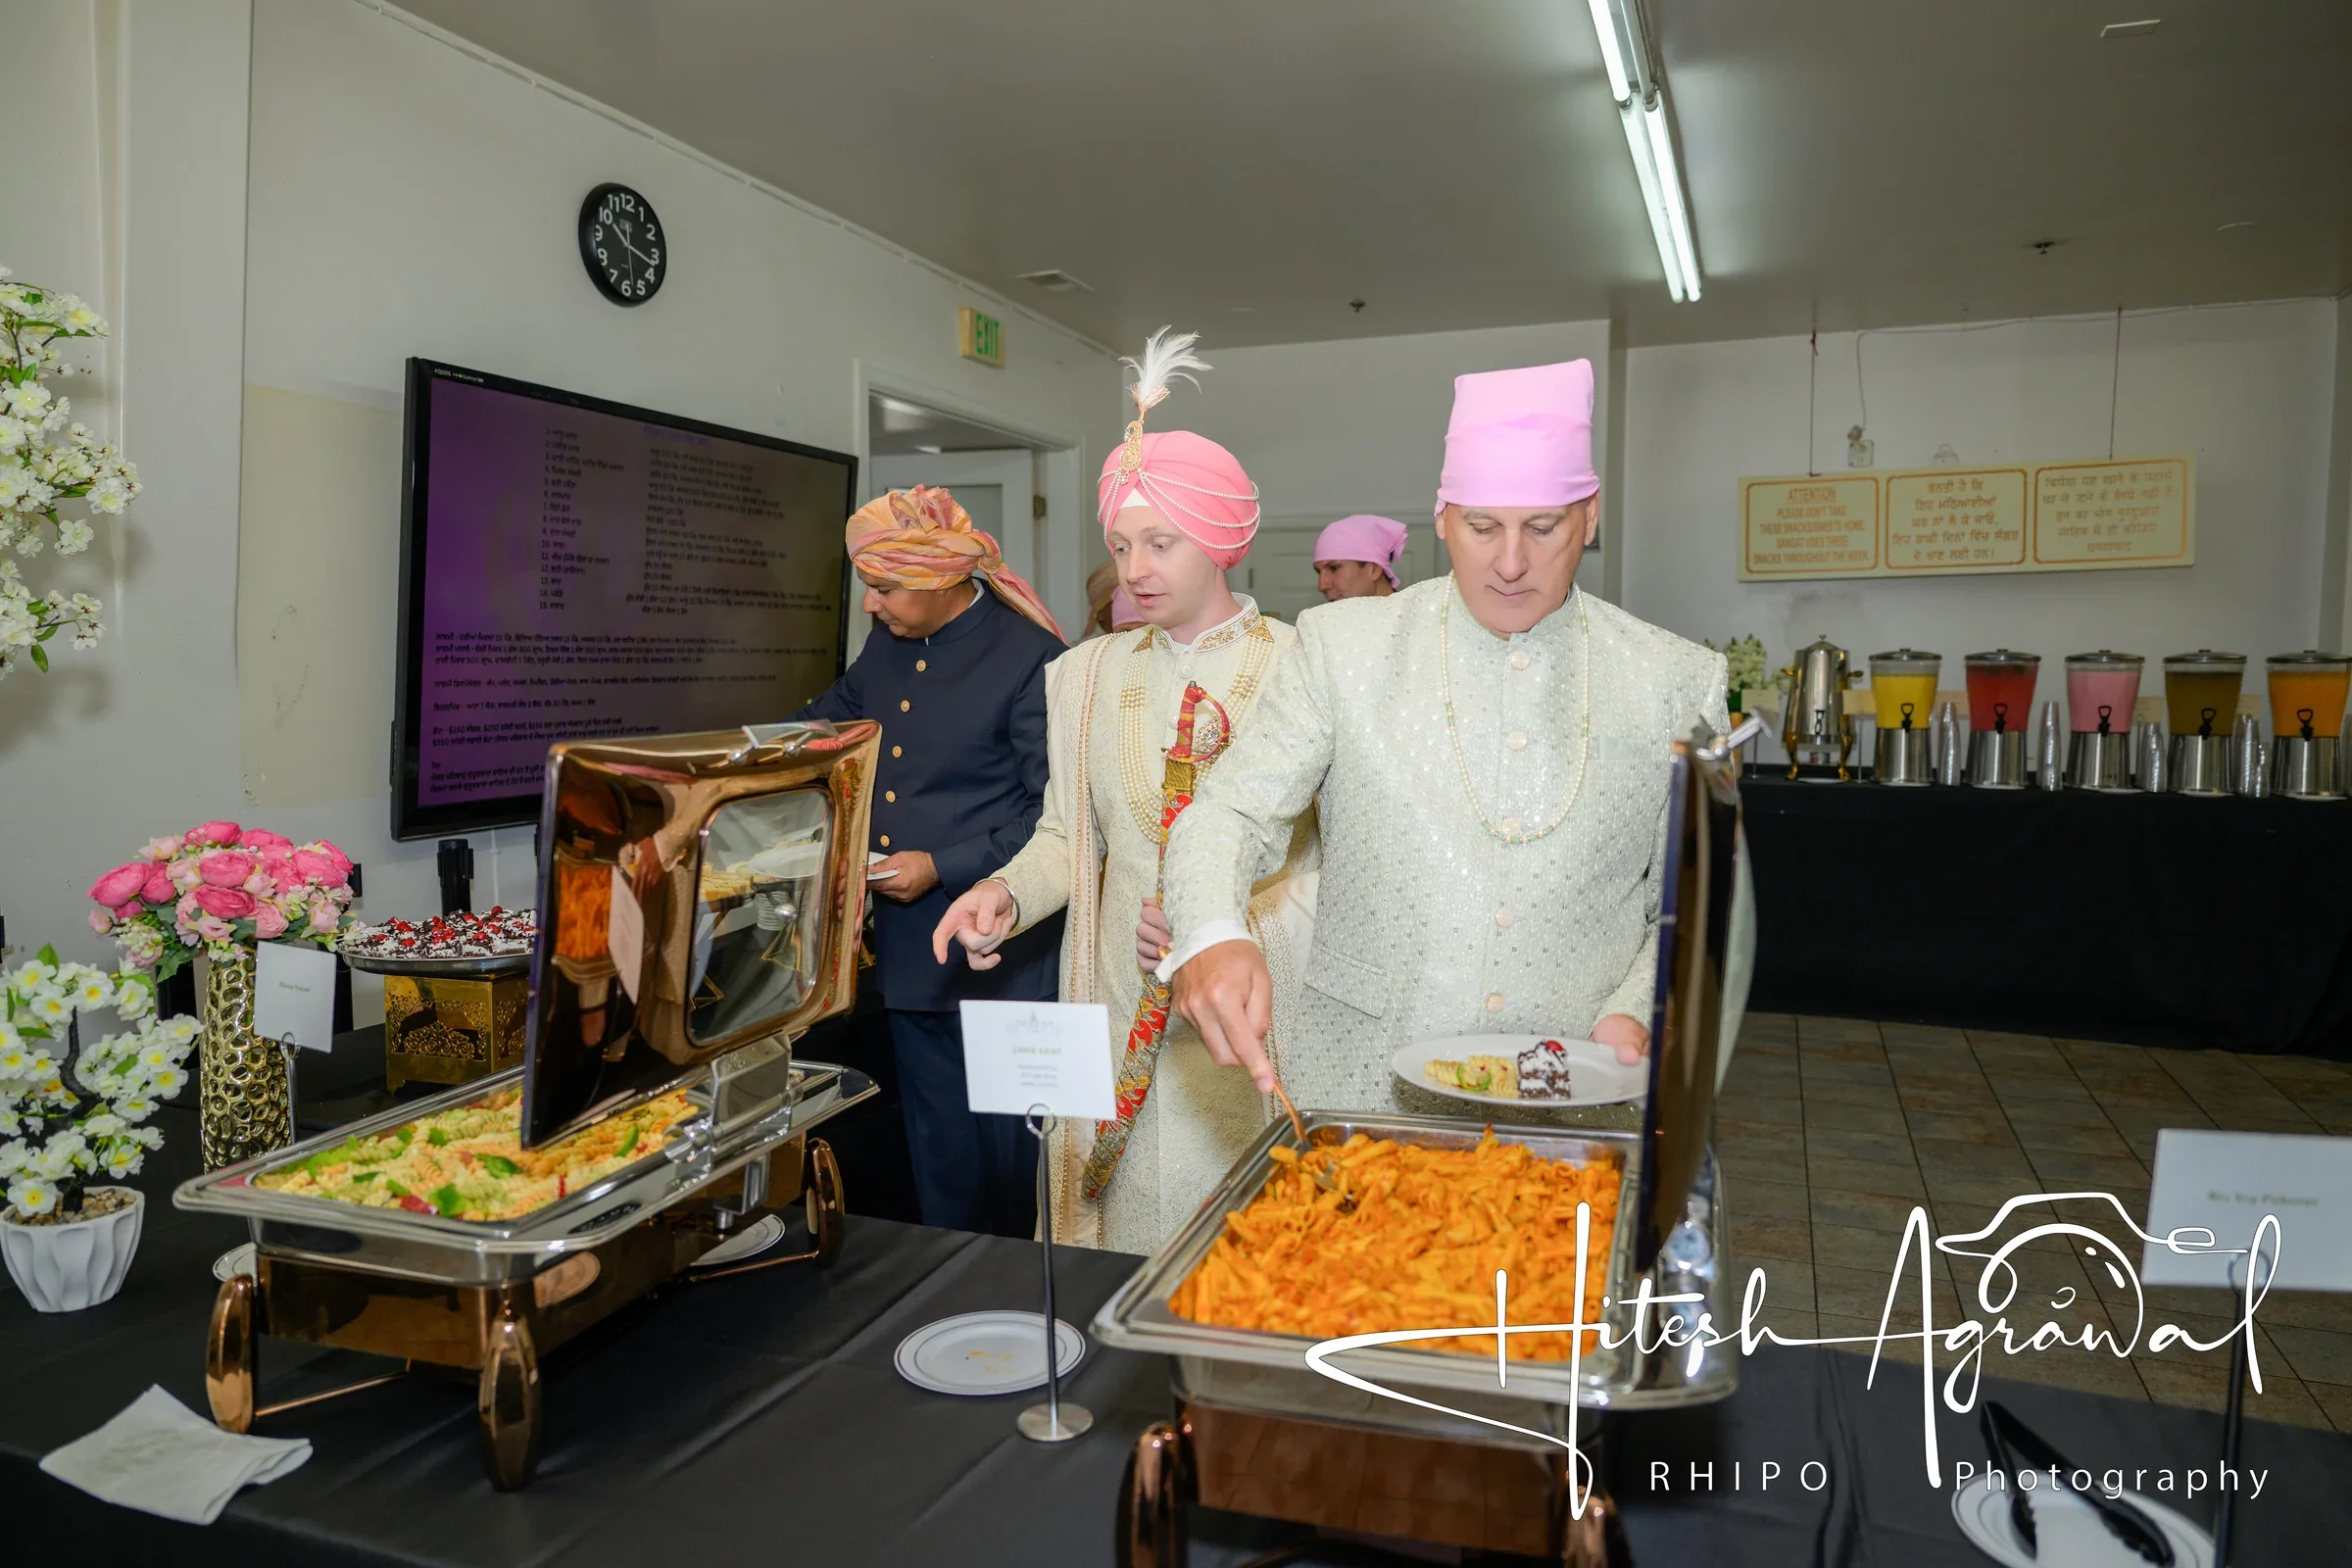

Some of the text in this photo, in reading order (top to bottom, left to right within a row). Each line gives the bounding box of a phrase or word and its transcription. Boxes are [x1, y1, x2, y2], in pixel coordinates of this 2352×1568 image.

[608, 193, 620, 213] 11
[620, 193, 635, 213] 12
[599, 206, 613, 225] 10
[638, 206, 645, 221] 1
[595, 224, 604, 242] 9
[646, 223, 656, 241] 2
[597, 247, 609, 267] 8
[650, 247, 661, 266] 3
[609, 268, 618, 284] 7
[644, 266, 656, 284] 4
[620, 279, 632, 297] 6
[636, 278, 647, 296] 5
[975, 314, 1000, 360] EXIT
[1787, 487, 1836, 502] ATTENTION
[1776, 508, 1804, 519] PLEASE
[1826, 505, 1847, 515] TAKE
[1760, 522, 1782, 534] THESE
[1826, 535, 1849, 547] THESE
[1752, 553, 1782, 564] SNACKS
